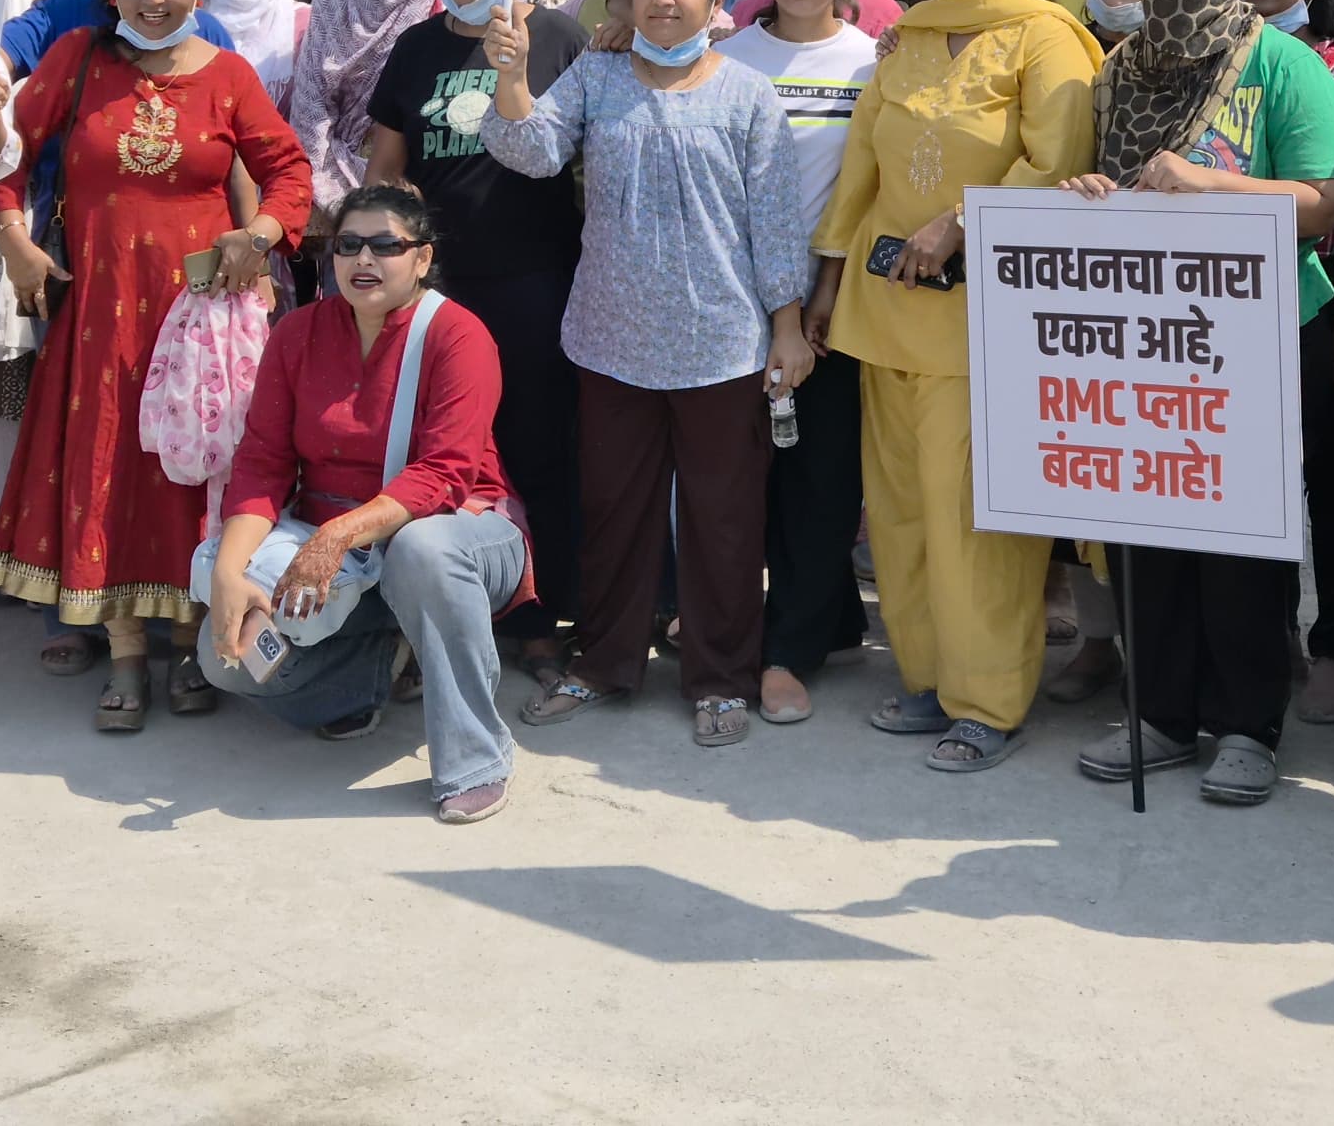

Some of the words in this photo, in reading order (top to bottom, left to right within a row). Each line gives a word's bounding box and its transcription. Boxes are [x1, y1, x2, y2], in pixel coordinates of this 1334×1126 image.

[433, 69, 499, 100] THER
[824, 89, 862, 98] REALIS
[992, 244, 1168, 295] बावधनचा
[1170, 250, 1266, 300] नारा
[1032, 311, 1129, 360] एकच
[1137, 304, 1224, 375] आहे,
[1038, 375, 1127, 427] RMC
[1131, 373, 1230, 434] प्लांट
[1038, 430, 1124, 493] बंदच
[1132, 438, 1223, 502] आहे!
